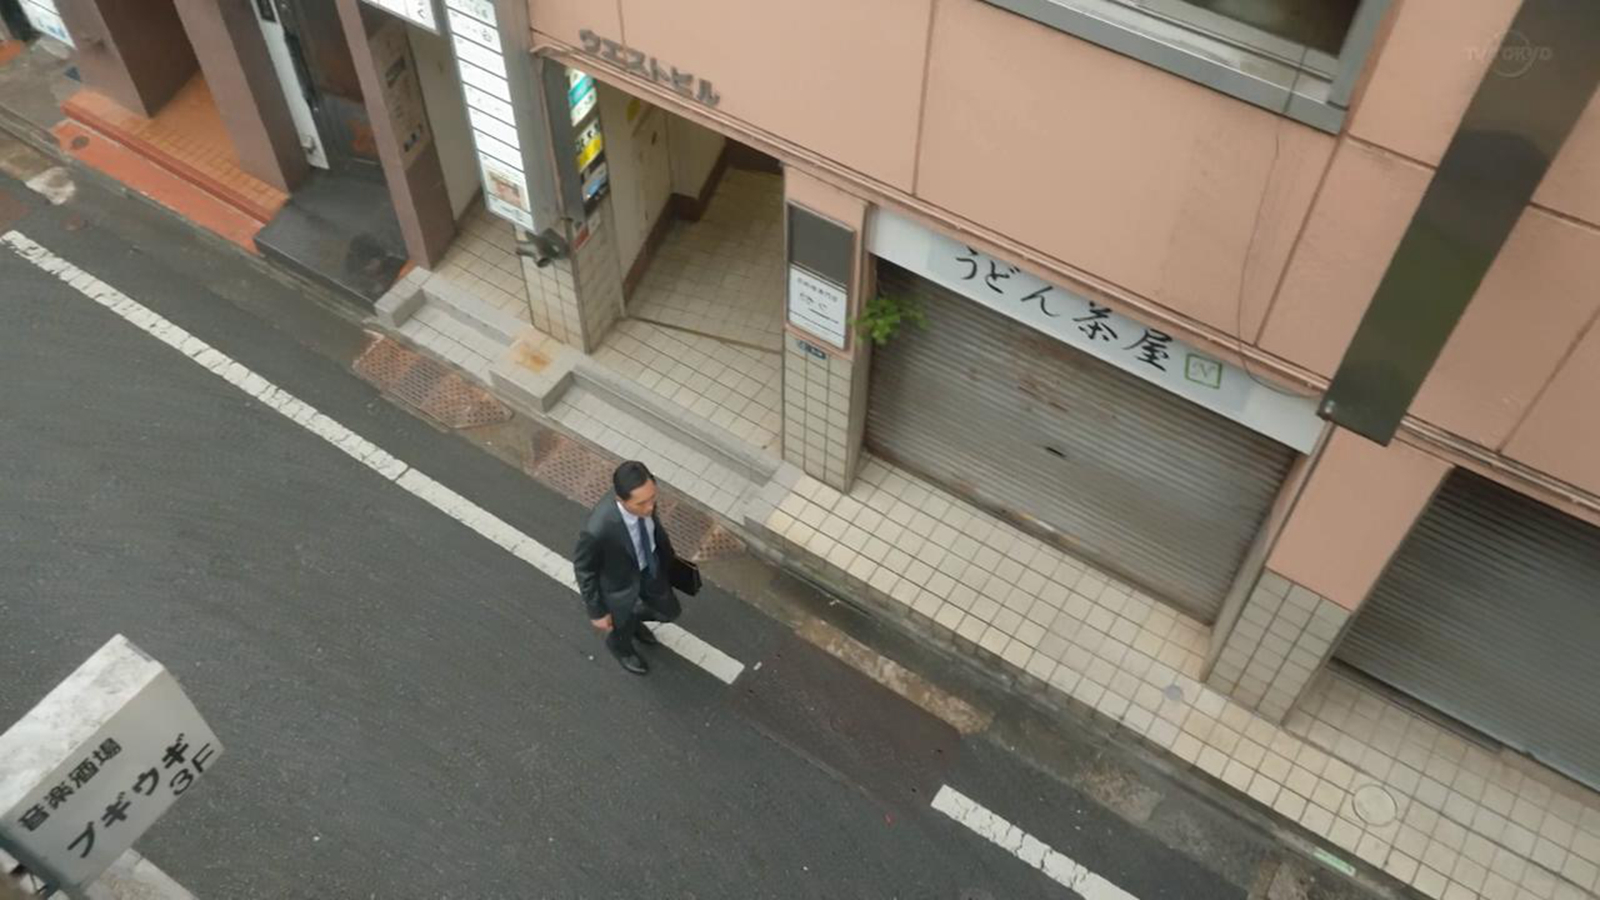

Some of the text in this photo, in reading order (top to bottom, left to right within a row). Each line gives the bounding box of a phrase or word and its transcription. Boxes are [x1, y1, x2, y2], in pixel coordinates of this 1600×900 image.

[579, 28, 720, 106] ウエストビル
[956, 245, 1173, 372] うどん茶屋
[18, 737, 122, 832] 音楽酒場
[169, 743, 214, 796] 3F
